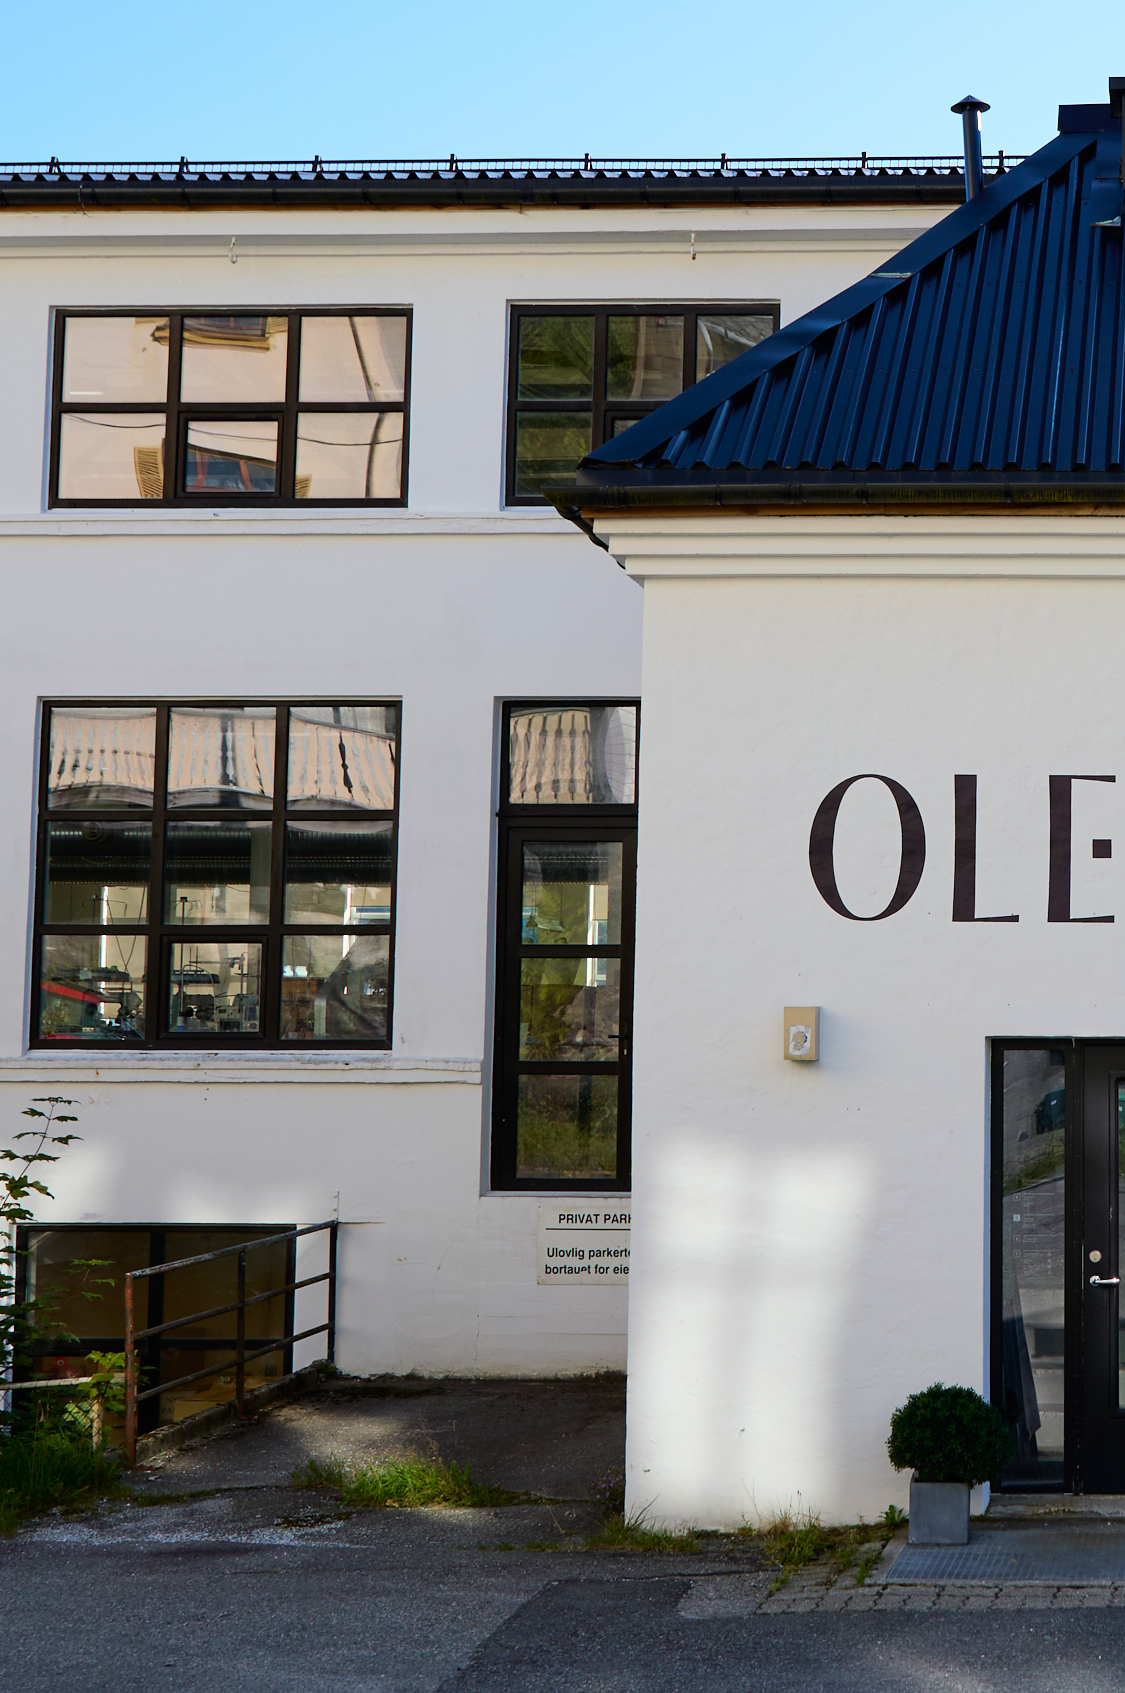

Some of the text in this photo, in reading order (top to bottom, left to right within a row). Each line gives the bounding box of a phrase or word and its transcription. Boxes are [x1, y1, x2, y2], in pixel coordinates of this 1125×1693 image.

[558, 1213, 601, 1224] PRIVAT
[547, 1247, 585, 1261] Ulovlig
[594, 1263, 610, 1275] for
